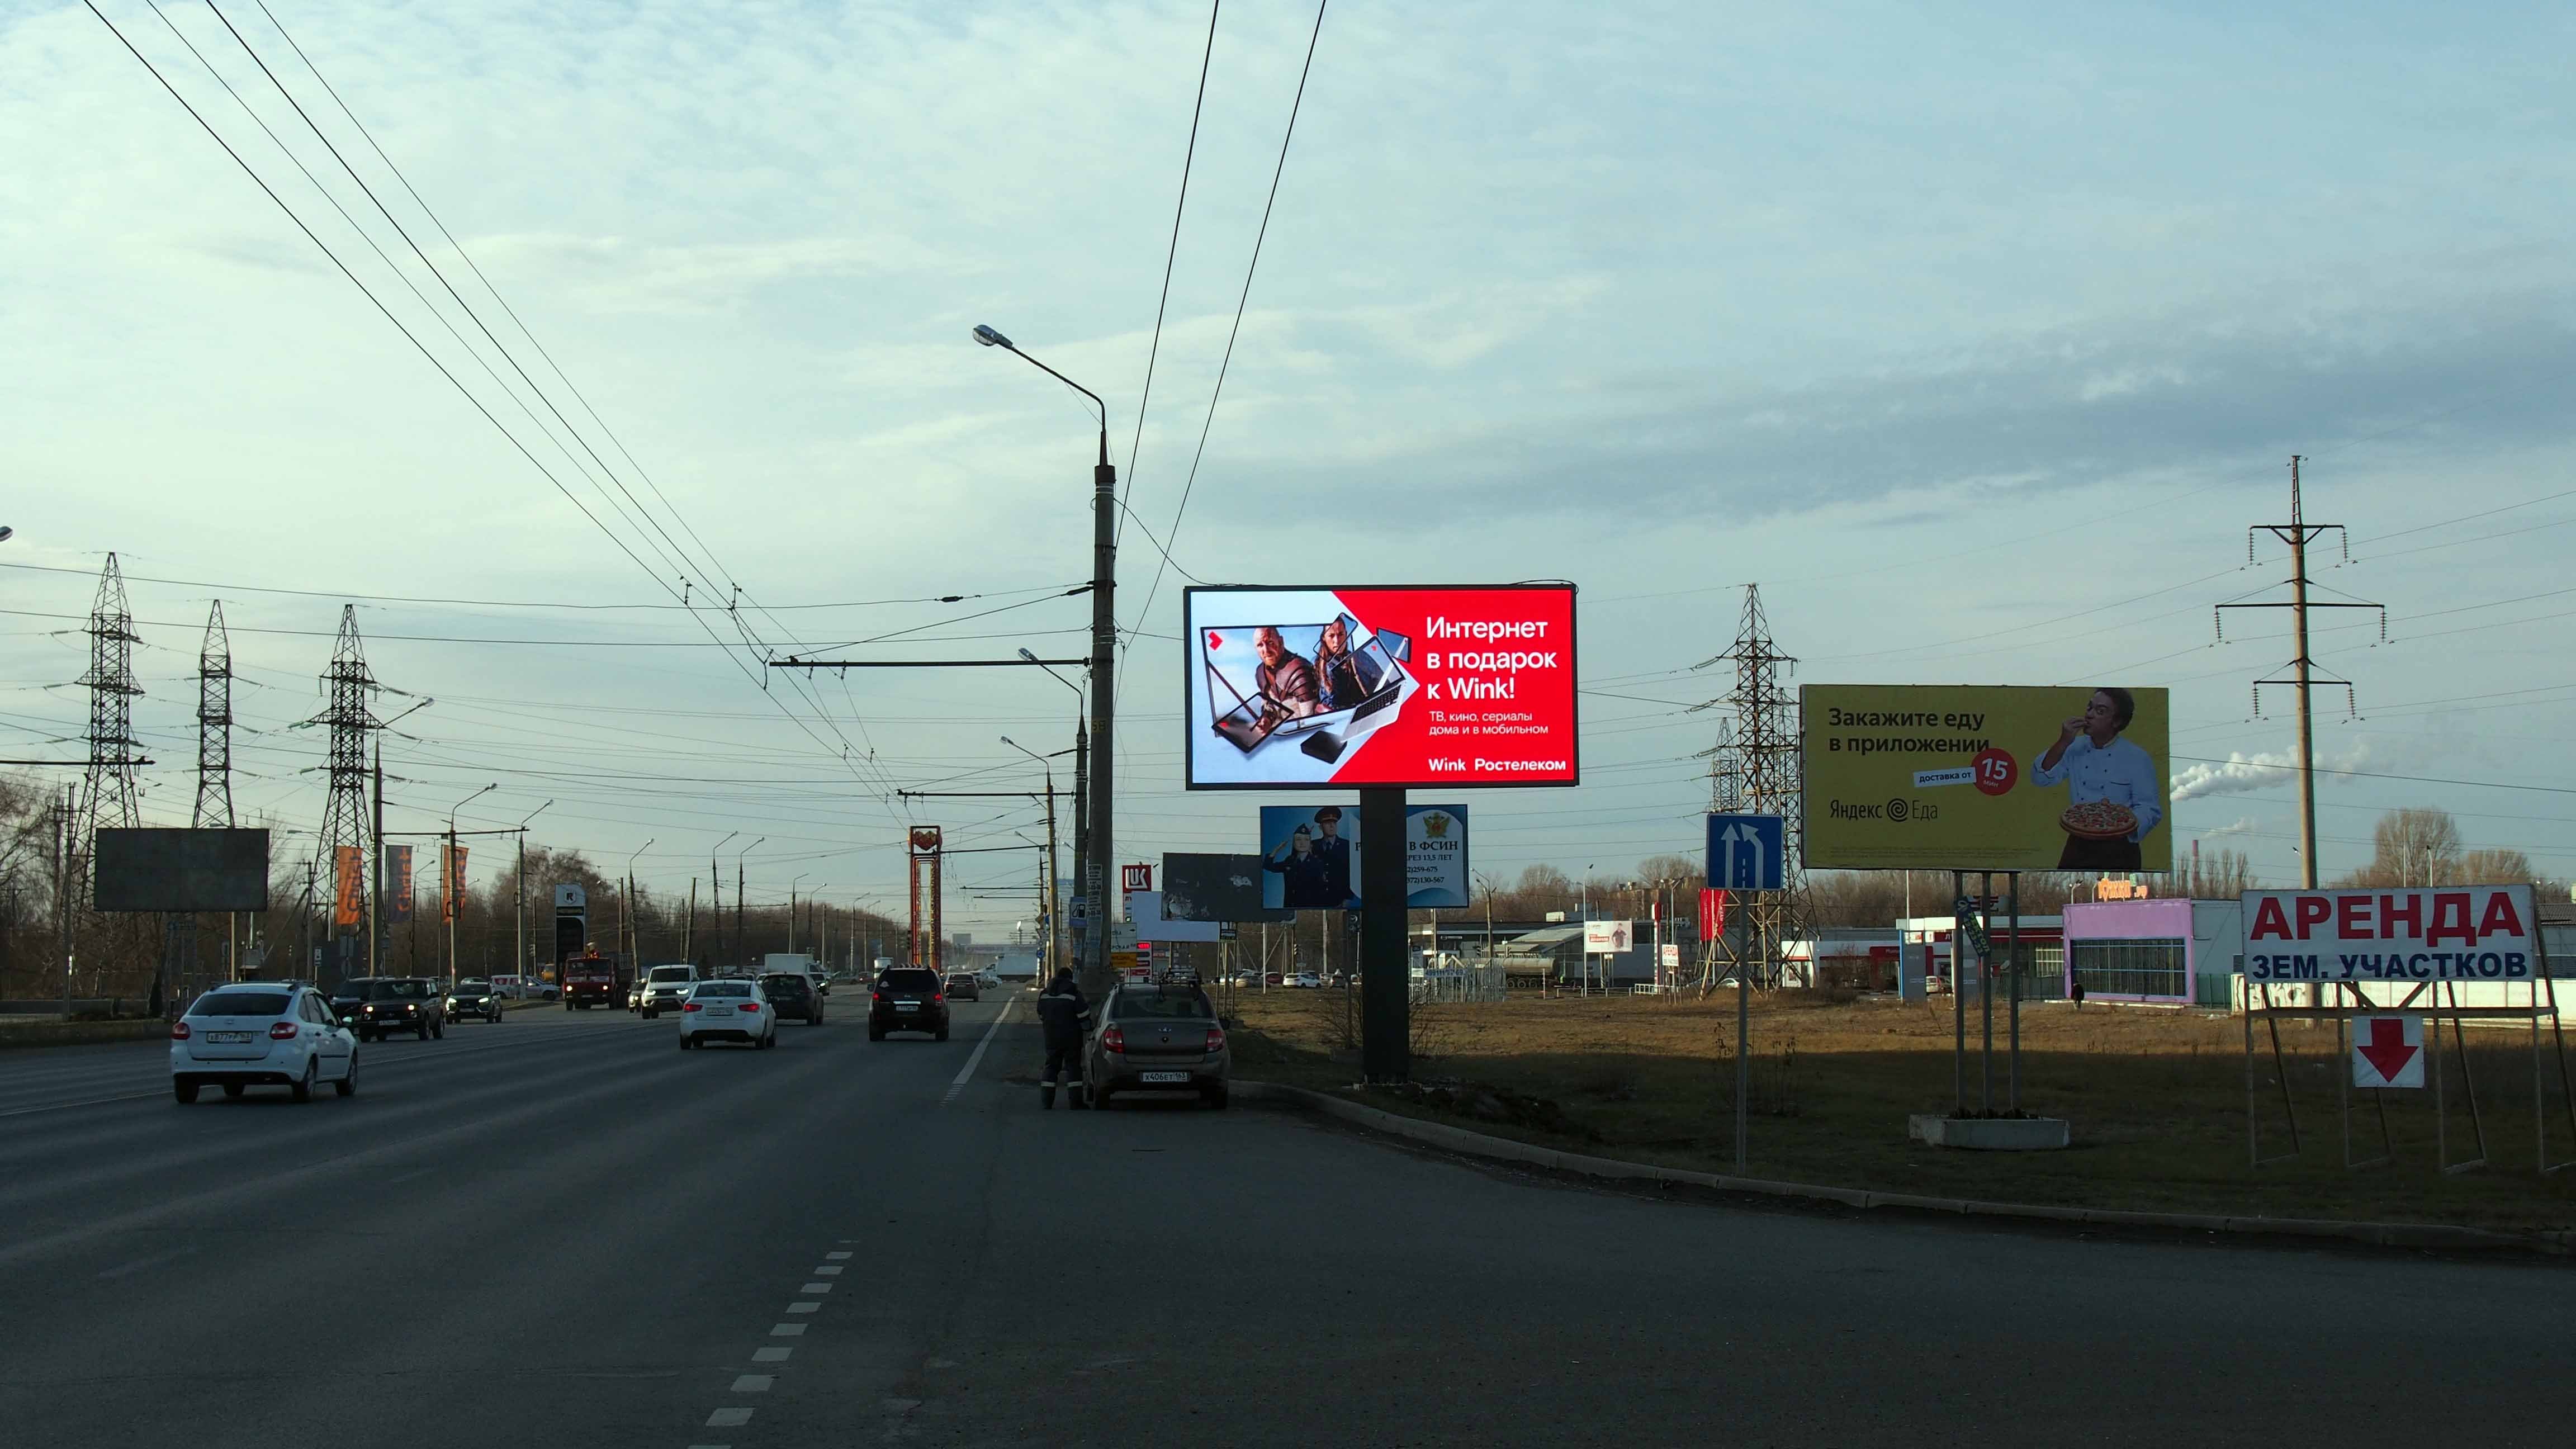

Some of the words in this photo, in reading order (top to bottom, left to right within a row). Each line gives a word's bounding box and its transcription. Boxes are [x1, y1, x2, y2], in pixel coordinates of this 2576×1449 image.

[1427, 616, 1548, 643] Интернет
[1427, 652, 1441, 669] в
[1449, 652, 1557, 674] подарок
[1427, 683, 1441, 699] к
[1447, 677, 1515, 699] Wink!
[1429, 711, 1447, 722] ТВ,
[1449, 713, 1479, 722] кино,
[1482, 713, 1532, 723] сериалы
[1829, 708, 1938, 726] Закажите
[1944, 713, 1985, 731] еду
[1429, 726, 1459, 736] дома
[1483, 723, 1549, 735] мобильном
[1829, 738, 1841, 751] в
[1848, 737, 1990, 755] приложении
[1428, 757, 1467, 771] Wink
[1474, 757, 1566, 771] Ростелеком
[1981, 756, 2009, 780] 15
[1919, 773, 1959, 783] доставка
[1830, 799, 1883, 820] Яндекс
[1912, 800, 1938, 821] Еда
[1409, 841, 1416, 850] В
[1419, 841, 1458, 850] ФСИН
[2250, 892, 2525, 947] АРЕНДА
[2252, 954, 2328, 979] ЗЕМ.
[2339, 952, 2528, 978] УЧАСТКОВ
